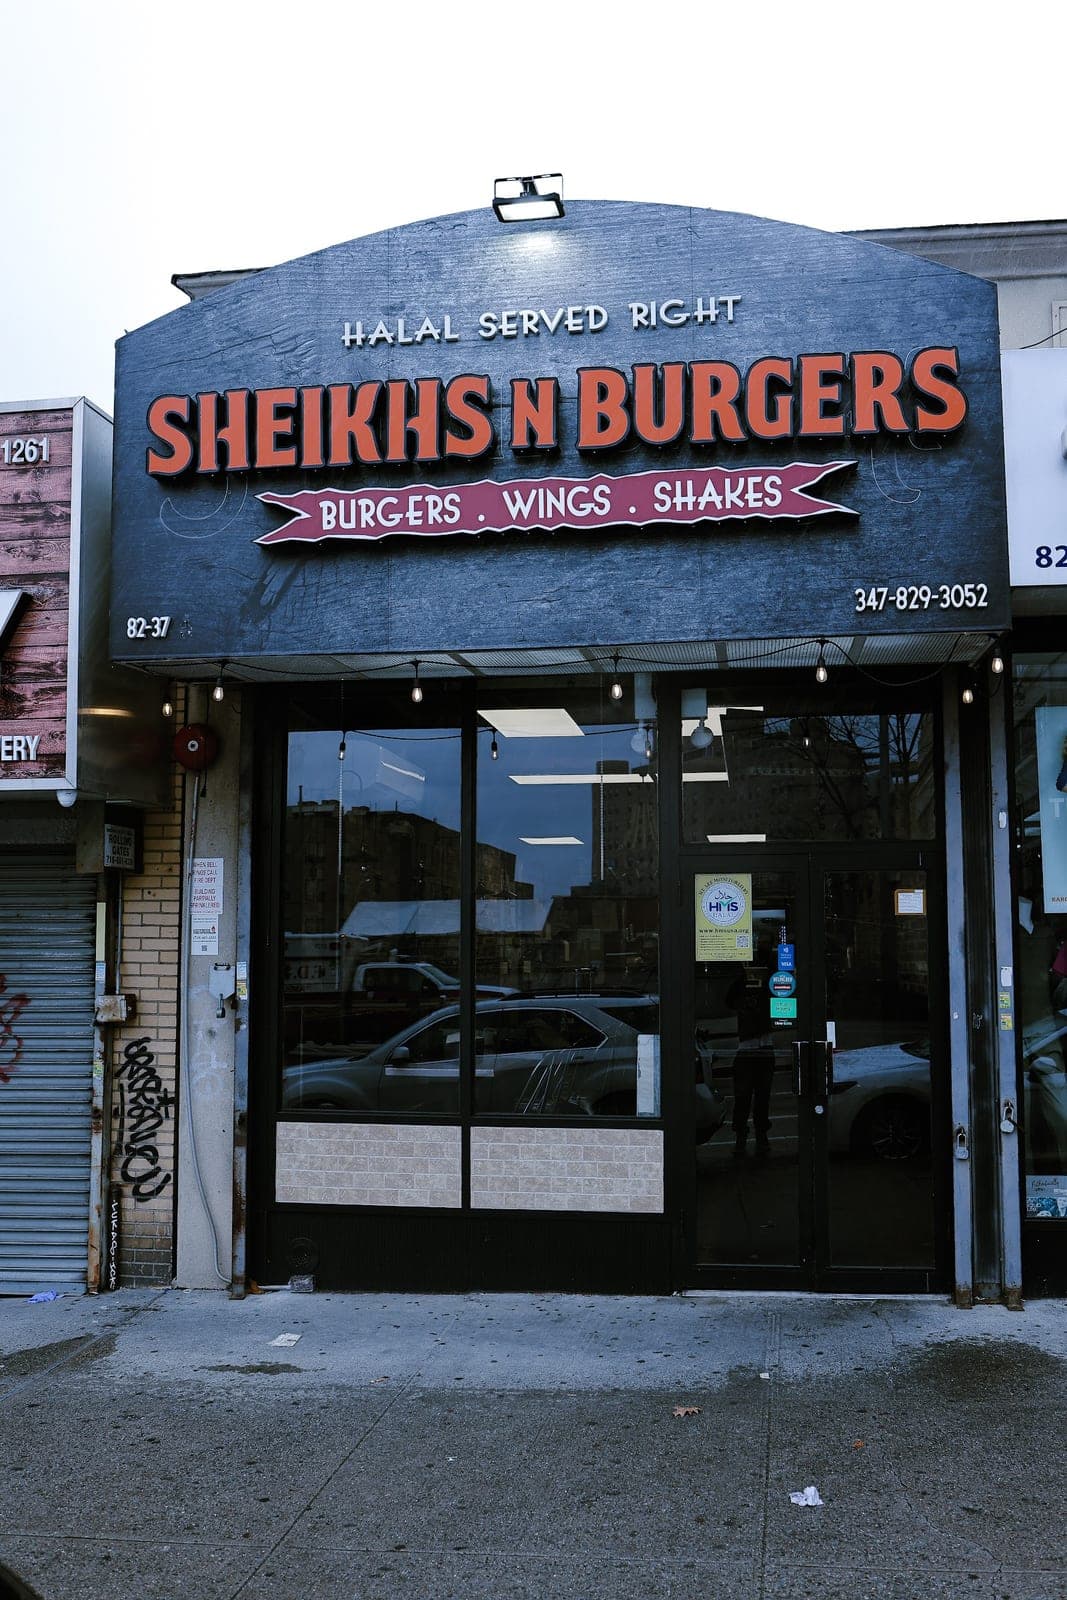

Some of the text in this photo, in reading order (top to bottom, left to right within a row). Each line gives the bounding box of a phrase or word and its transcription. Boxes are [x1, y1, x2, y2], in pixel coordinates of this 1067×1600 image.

[341, 295, 741, 348] HALAL SERVED RIGHT
[146, 345, 968, 477] SHEIKHS N BURGERS
[1, 437, 50, 465] 1261
[319, 475, 783, 530] BURGERS WINGS SHAKES
[854, 583, 988, 612] 347-829-3052
[127, 616, 171, 638] 82-37
